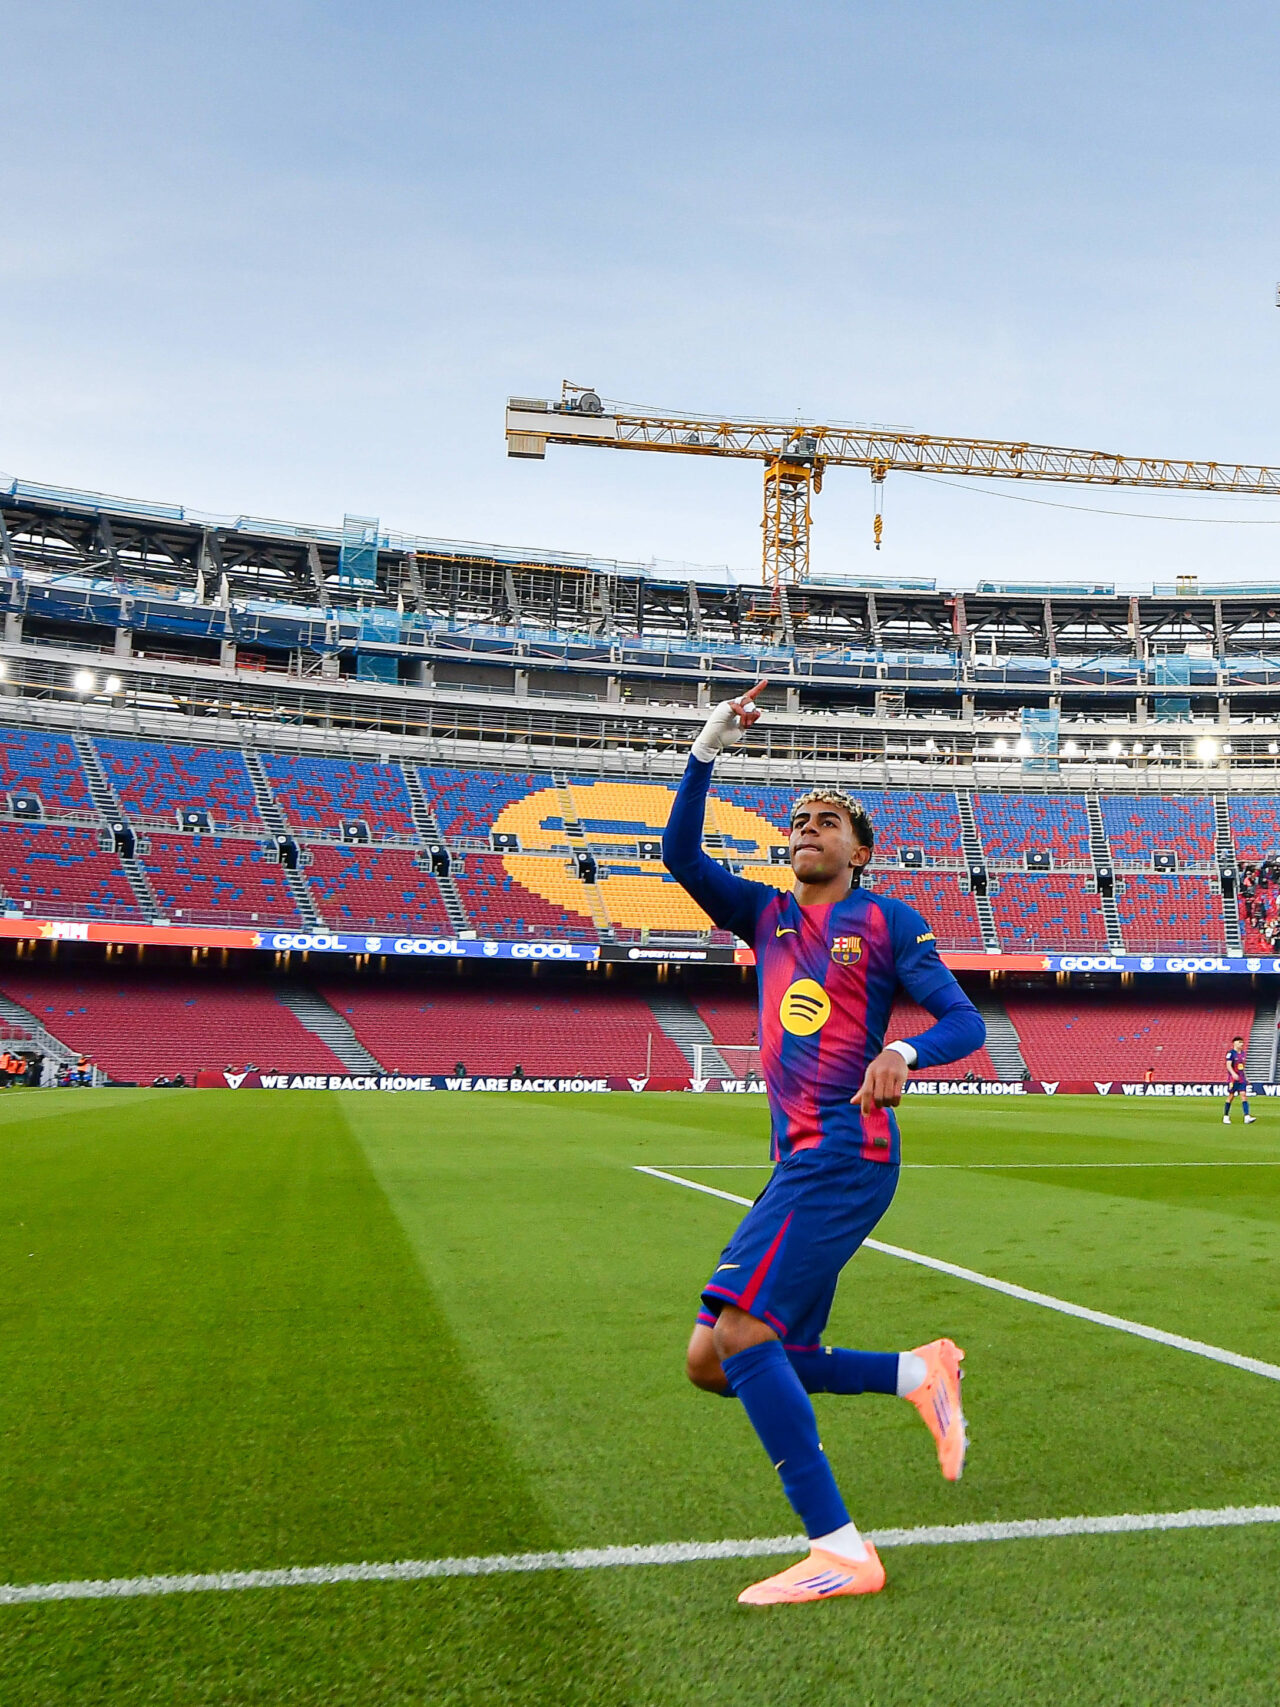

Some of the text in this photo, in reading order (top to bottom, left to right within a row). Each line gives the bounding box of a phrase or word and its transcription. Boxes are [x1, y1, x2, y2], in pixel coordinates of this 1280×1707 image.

[272, 934, 347, 950] GOOL
[394, 939, 466, 954] GOOL
[511, 944, 580, 958] GOOL
[1060, 957, 1124, 970] GOOL
[1166, 957, 1230, 972] GOOL
[259, 1075, 435, 1091] WE ARE BACK HOME.
[445, 1078, 611, 1093] WE ARE BACK HOME.
[721, 1080, 767, 1093] WE AR
[907, 1081, 939, 1094] ARE
[939, 1082, 980, 1095] BACK
[982, 1082, 1027, 1096] HOME.
[1122, 1083, 1144, 1096] WE
[1144, 1083, 1175, 1096] ARE
[1175, 1084, 1214, 1096] BACK
